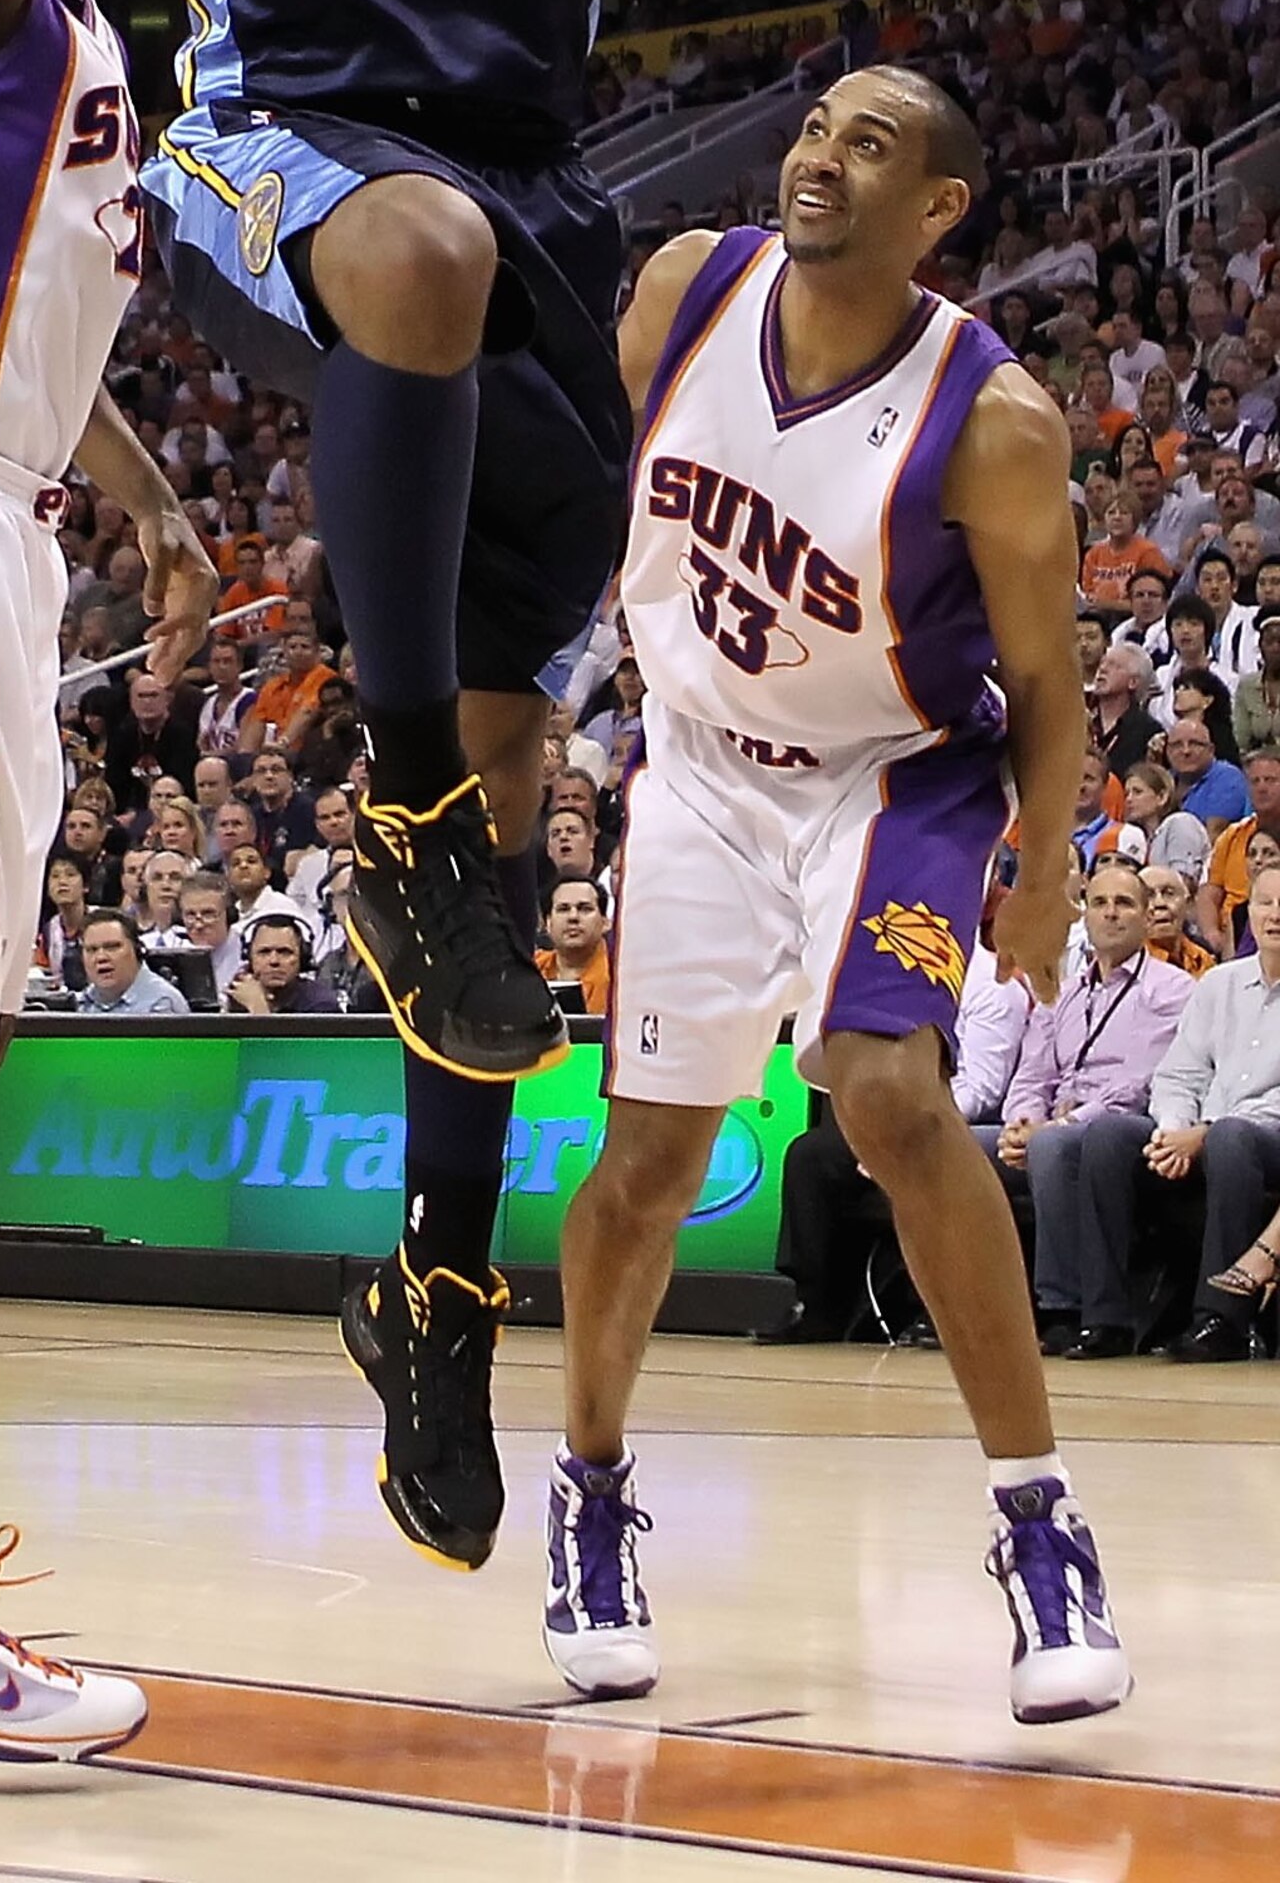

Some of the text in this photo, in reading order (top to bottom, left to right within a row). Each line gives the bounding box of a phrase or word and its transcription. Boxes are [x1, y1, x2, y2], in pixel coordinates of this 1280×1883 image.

[648, 456, 862, 636] SUNS
[688, 542, 780, 676] 33
[7, 1075, 590, 1194] AutoTraer
